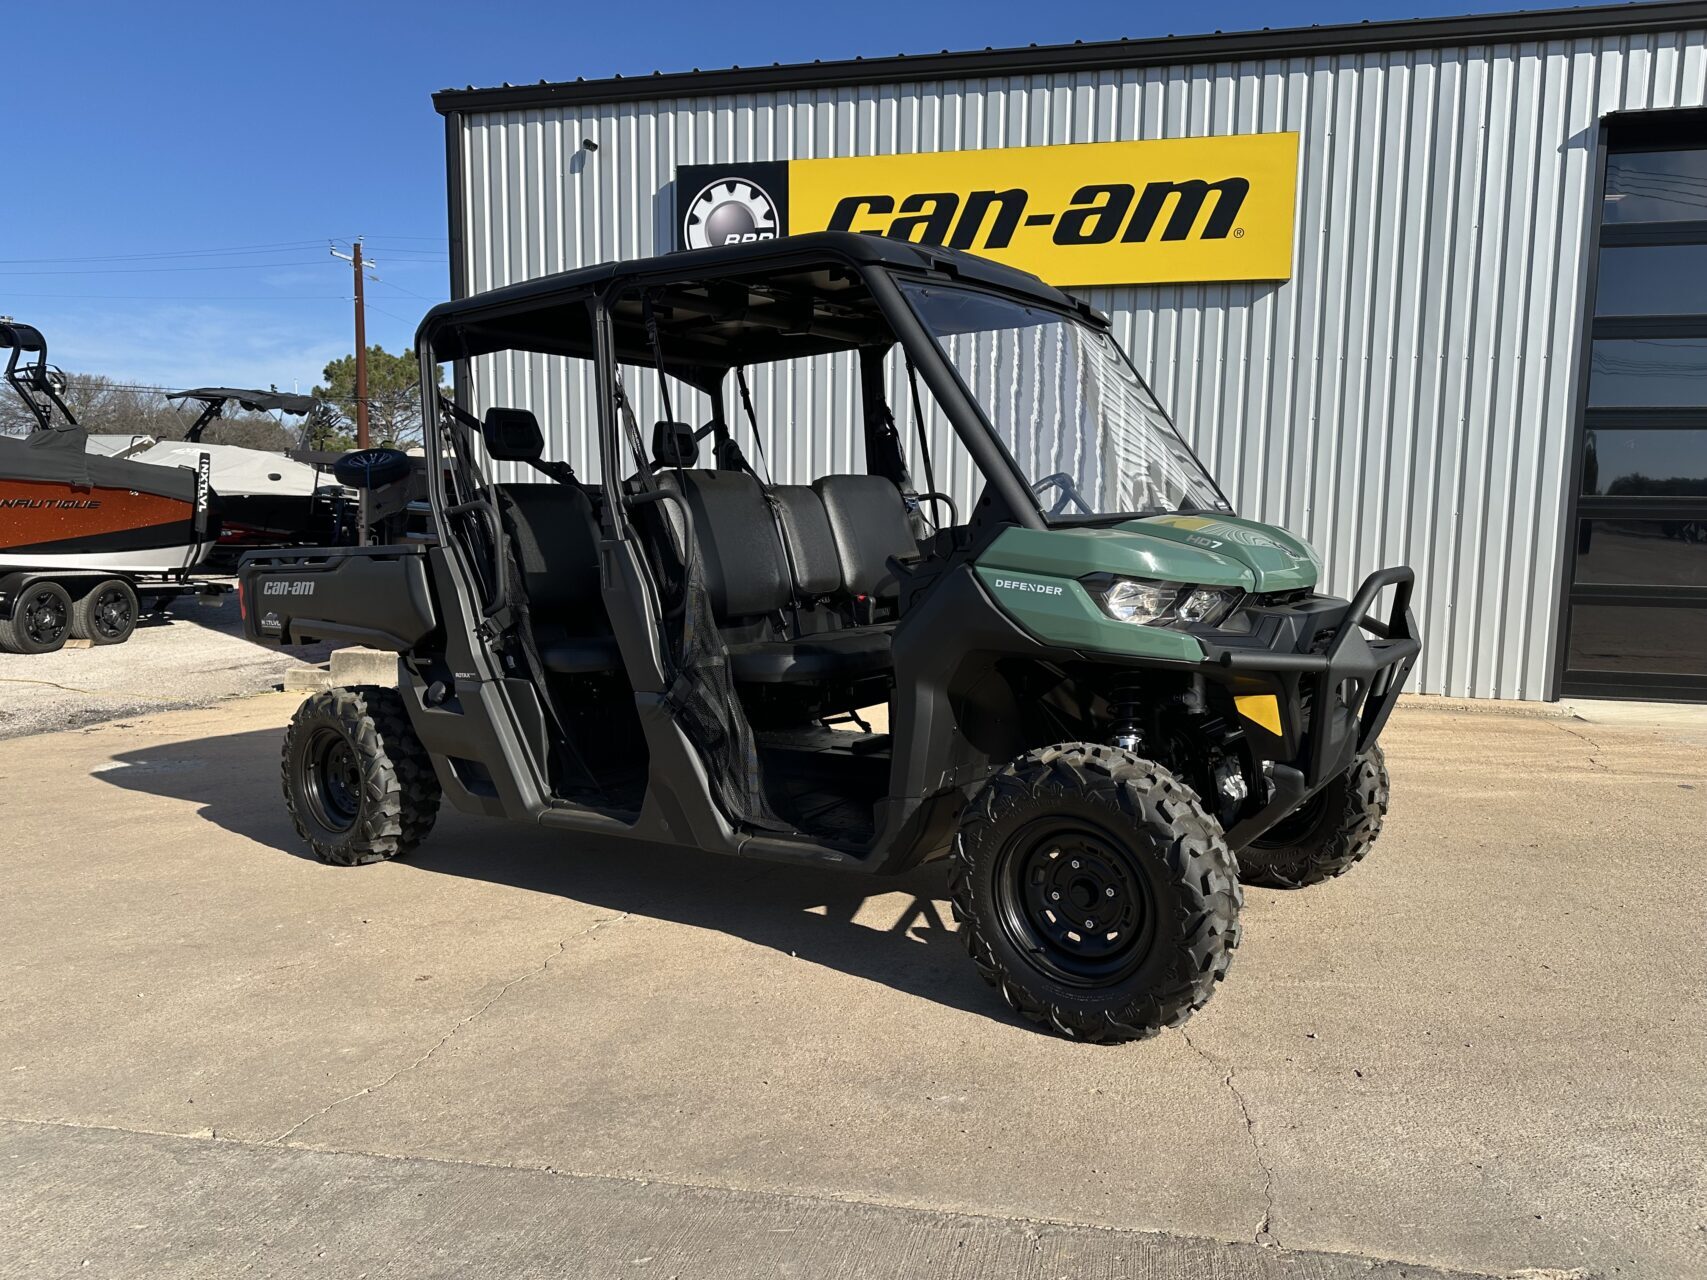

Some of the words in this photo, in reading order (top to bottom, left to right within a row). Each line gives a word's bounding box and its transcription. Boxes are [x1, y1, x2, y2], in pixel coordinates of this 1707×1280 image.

[826, 177, 1250, 250] can-am
[198, 463, 209, 513] NXTLVL
[0, 499, 102, 510] NAUTIQUE
[1186, 534, 1223, 549] HD7
[263, 581, 315, 595] can-am
[995, 578, 1063, 597] DEFENDER
